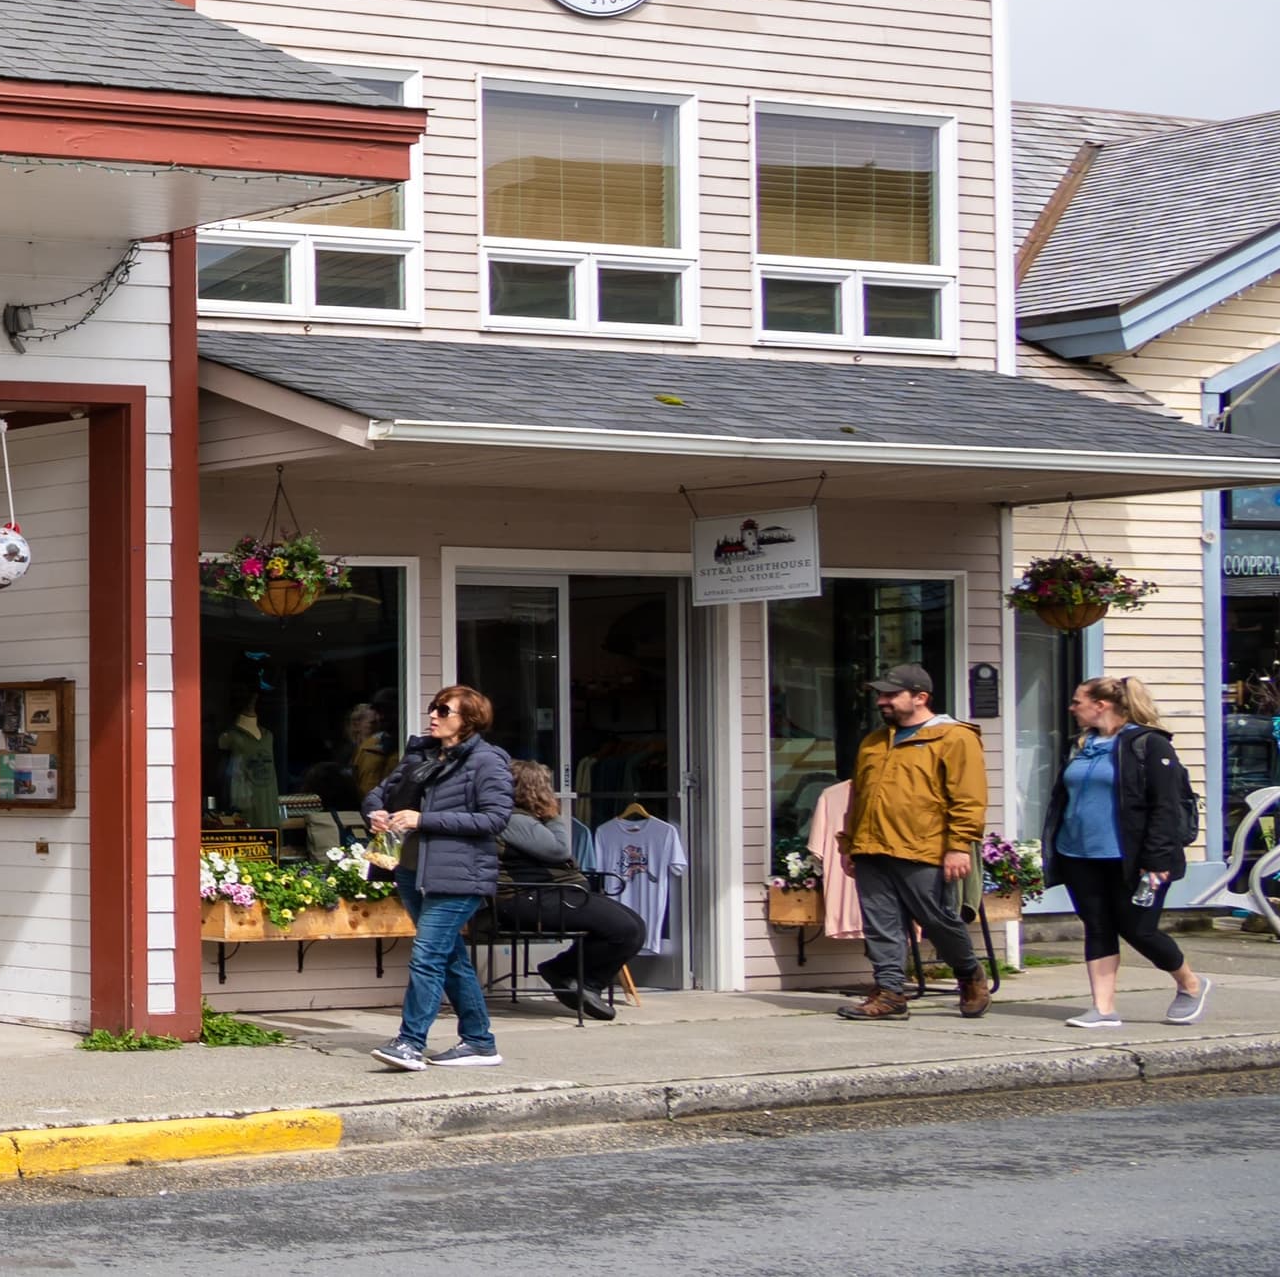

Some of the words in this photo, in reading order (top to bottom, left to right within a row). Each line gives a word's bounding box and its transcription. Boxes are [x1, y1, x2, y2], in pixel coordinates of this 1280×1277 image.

[699, 566, 733, 577] SITKA
[736, 559, 813, 573] LIGHTHOUSE
[750, 572, 781, 581] STORE
